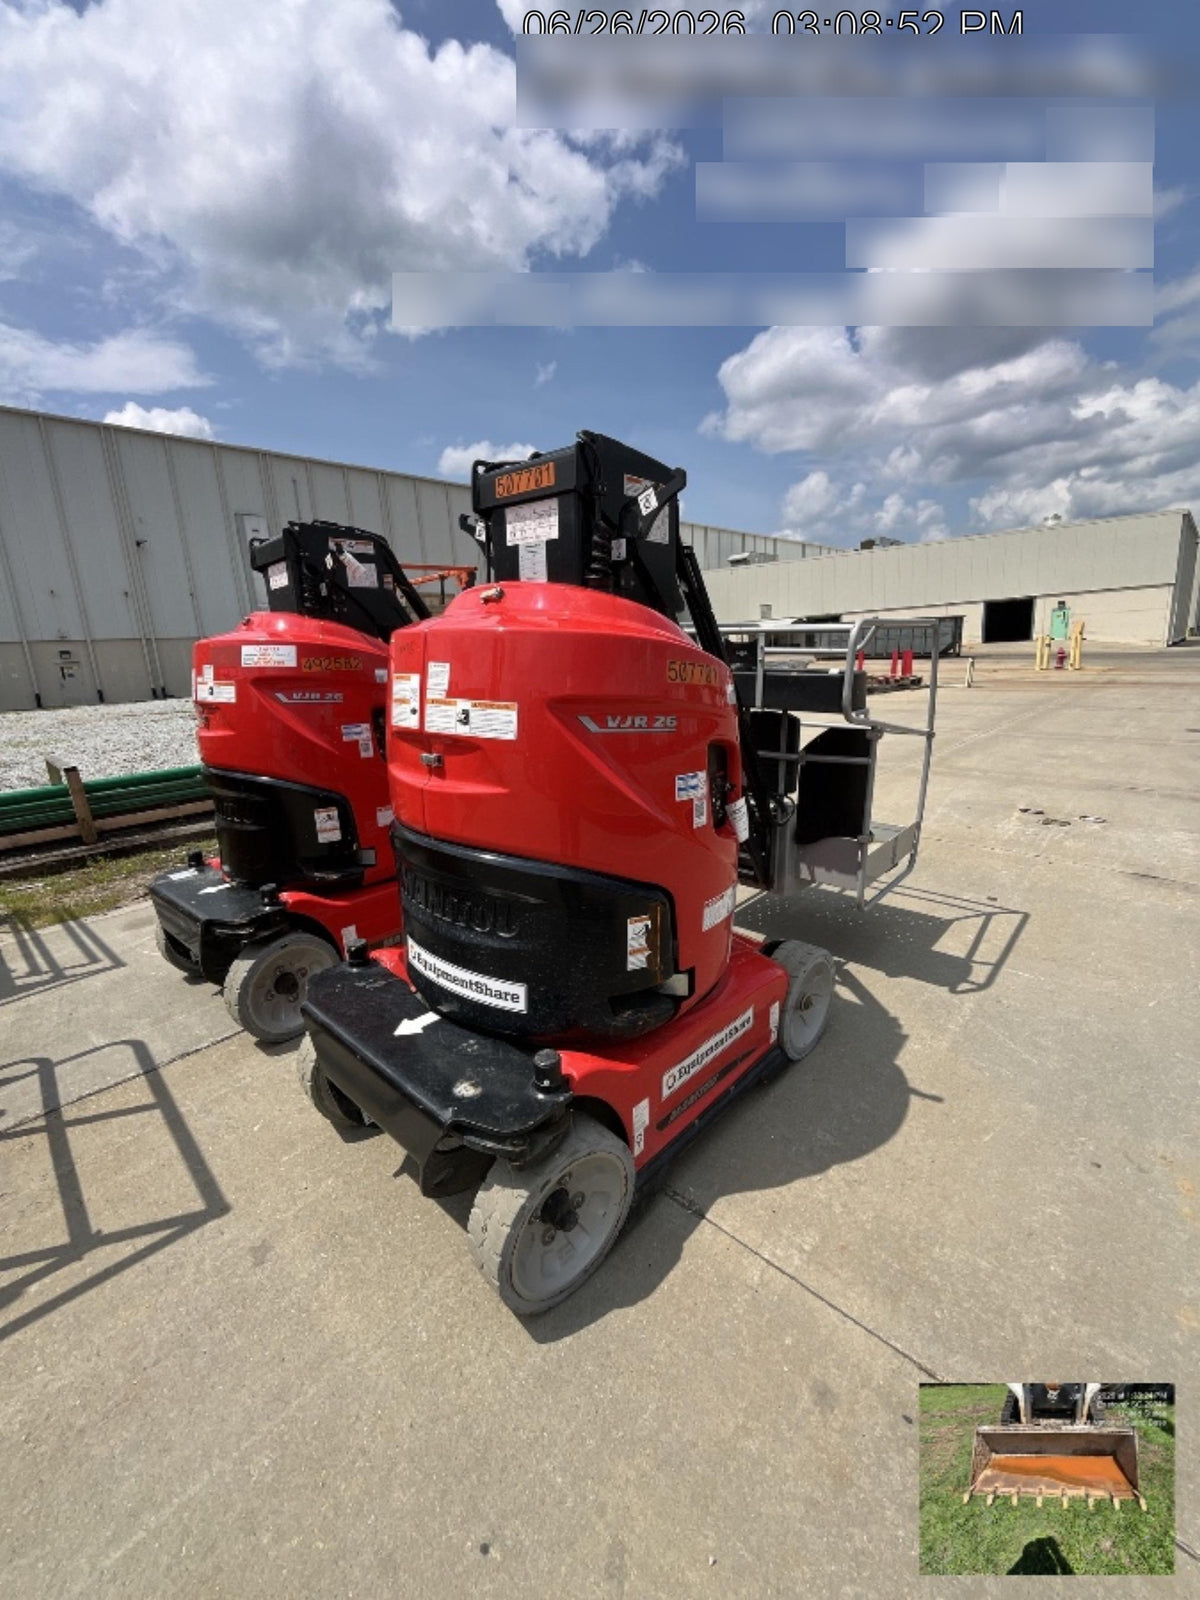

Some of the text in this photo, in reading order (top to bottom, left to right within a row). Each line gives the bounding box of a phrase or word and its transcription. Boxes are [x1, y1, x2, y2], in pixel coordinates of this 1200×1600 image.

[606, 714, 677, 728] VJR 26
[416, 950, 520, 1004] EquipmentShare
[676, 1014, 752, 1082] EquipmentShare
